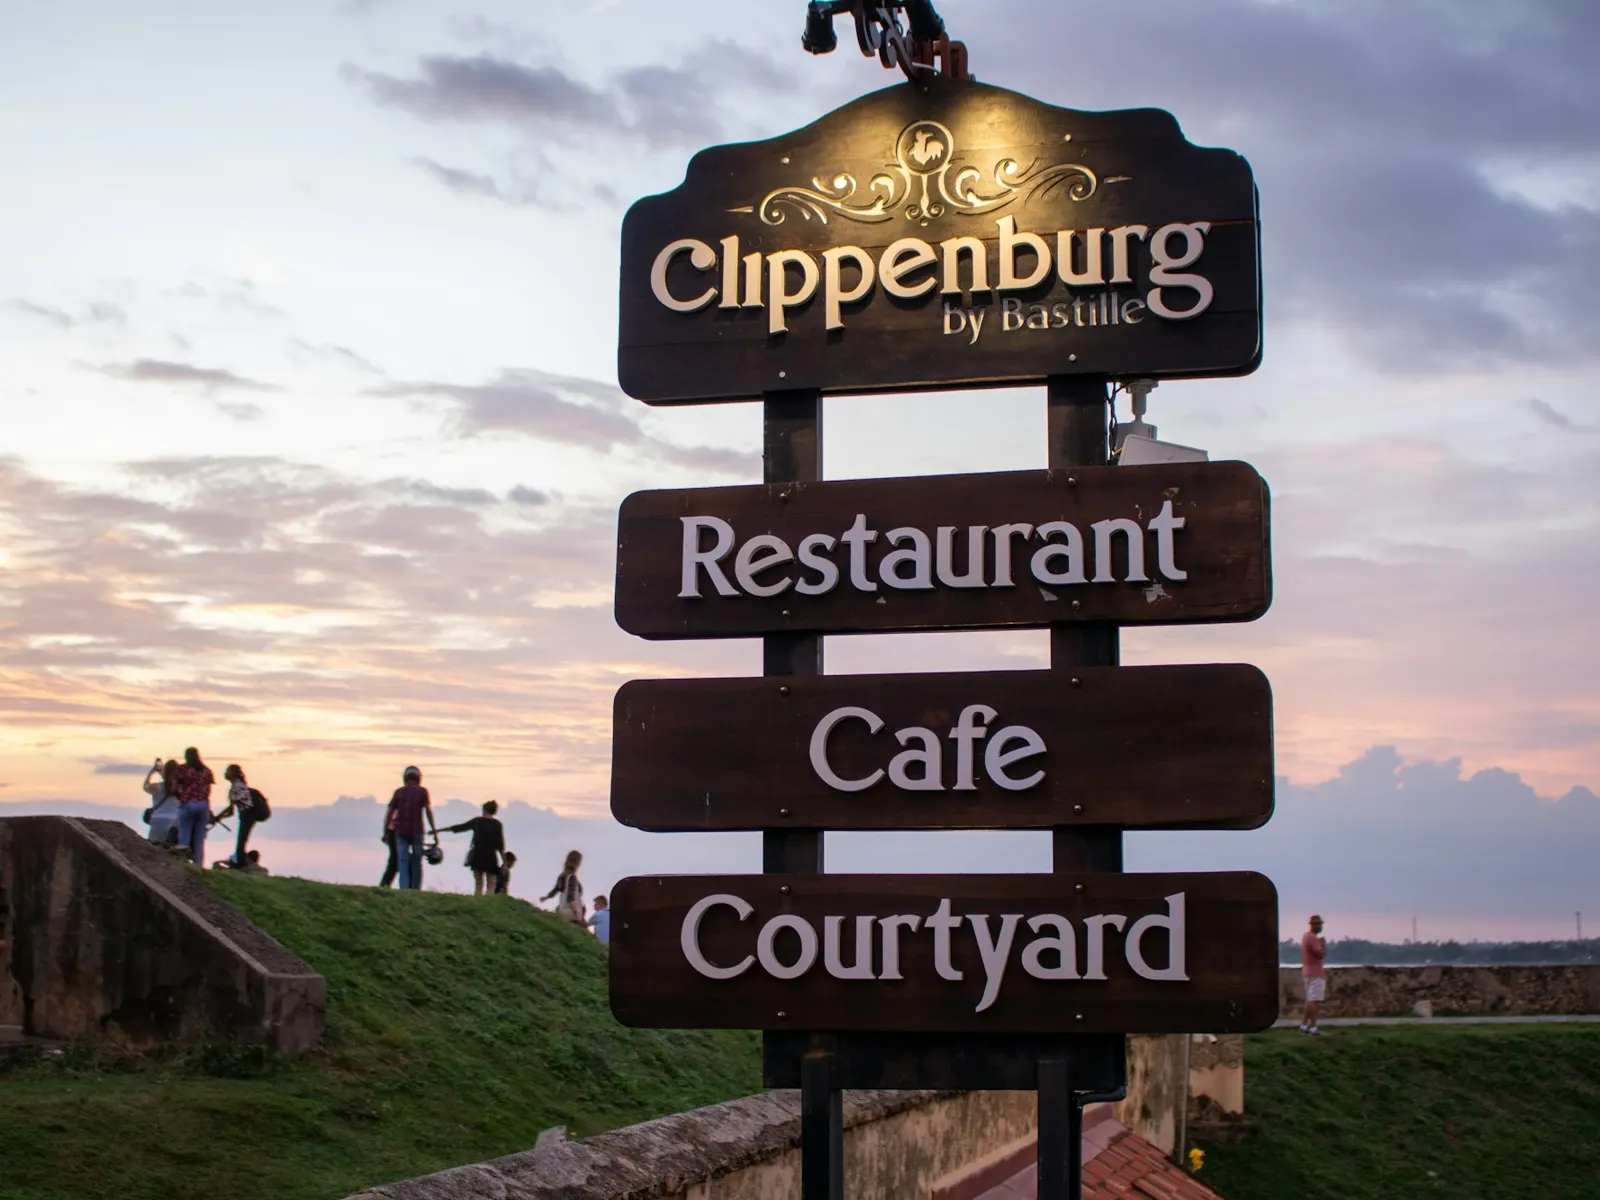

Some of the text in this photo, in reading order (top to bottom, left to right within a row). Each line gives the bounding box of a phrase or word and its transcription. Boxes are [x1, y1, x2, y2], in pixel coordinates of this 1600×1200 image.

[650, 215, 1214, 334] Clippenburg
[942, 291, 1146, 345] by Bastille
[677, 500, 1188, 598] Restaurant
[809, 704, 1048, 792] Cafe
[680, 892, 1191, 1013] Courtyard
